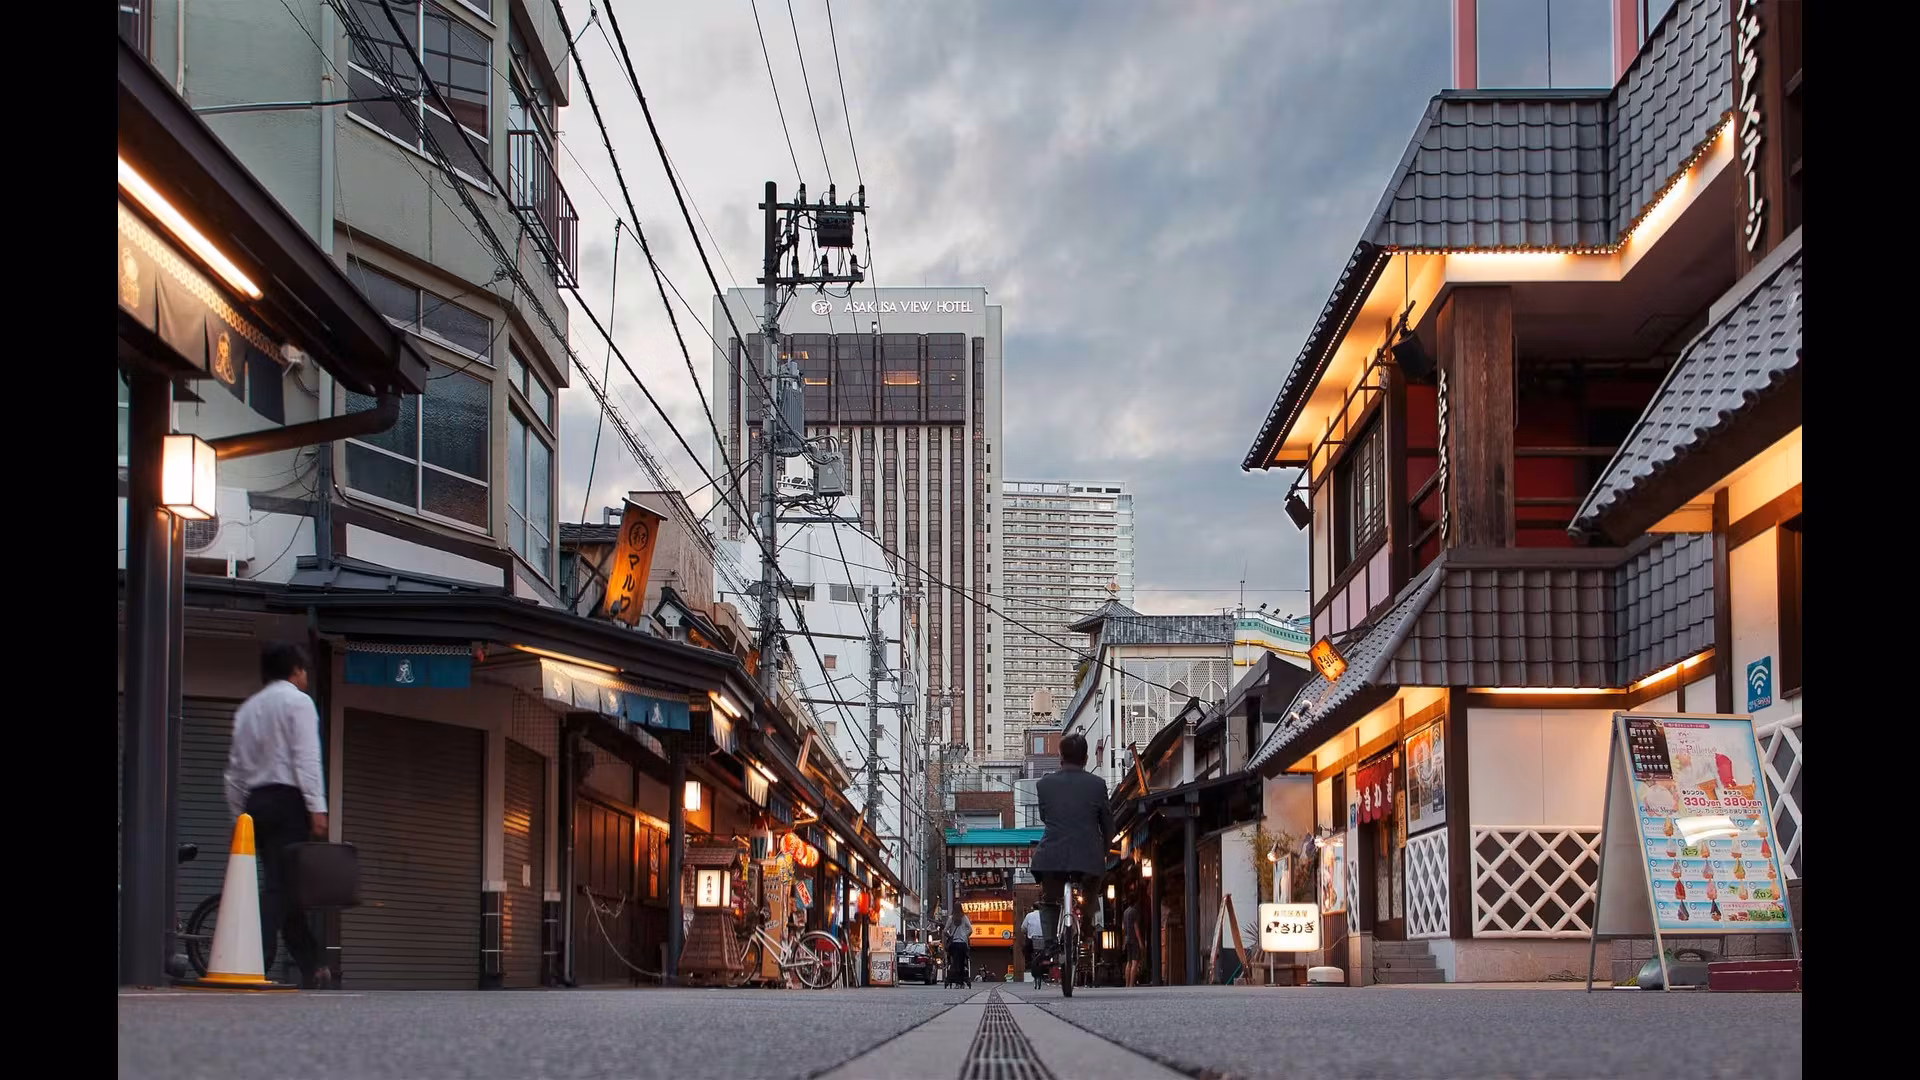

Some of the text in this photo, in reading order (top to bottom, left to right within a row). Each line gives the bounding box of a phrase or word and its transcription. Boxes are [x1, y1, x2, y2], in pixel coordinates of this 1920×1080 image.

[844, 301, 973, 313] ASAKUSA VIEW HOTEL
